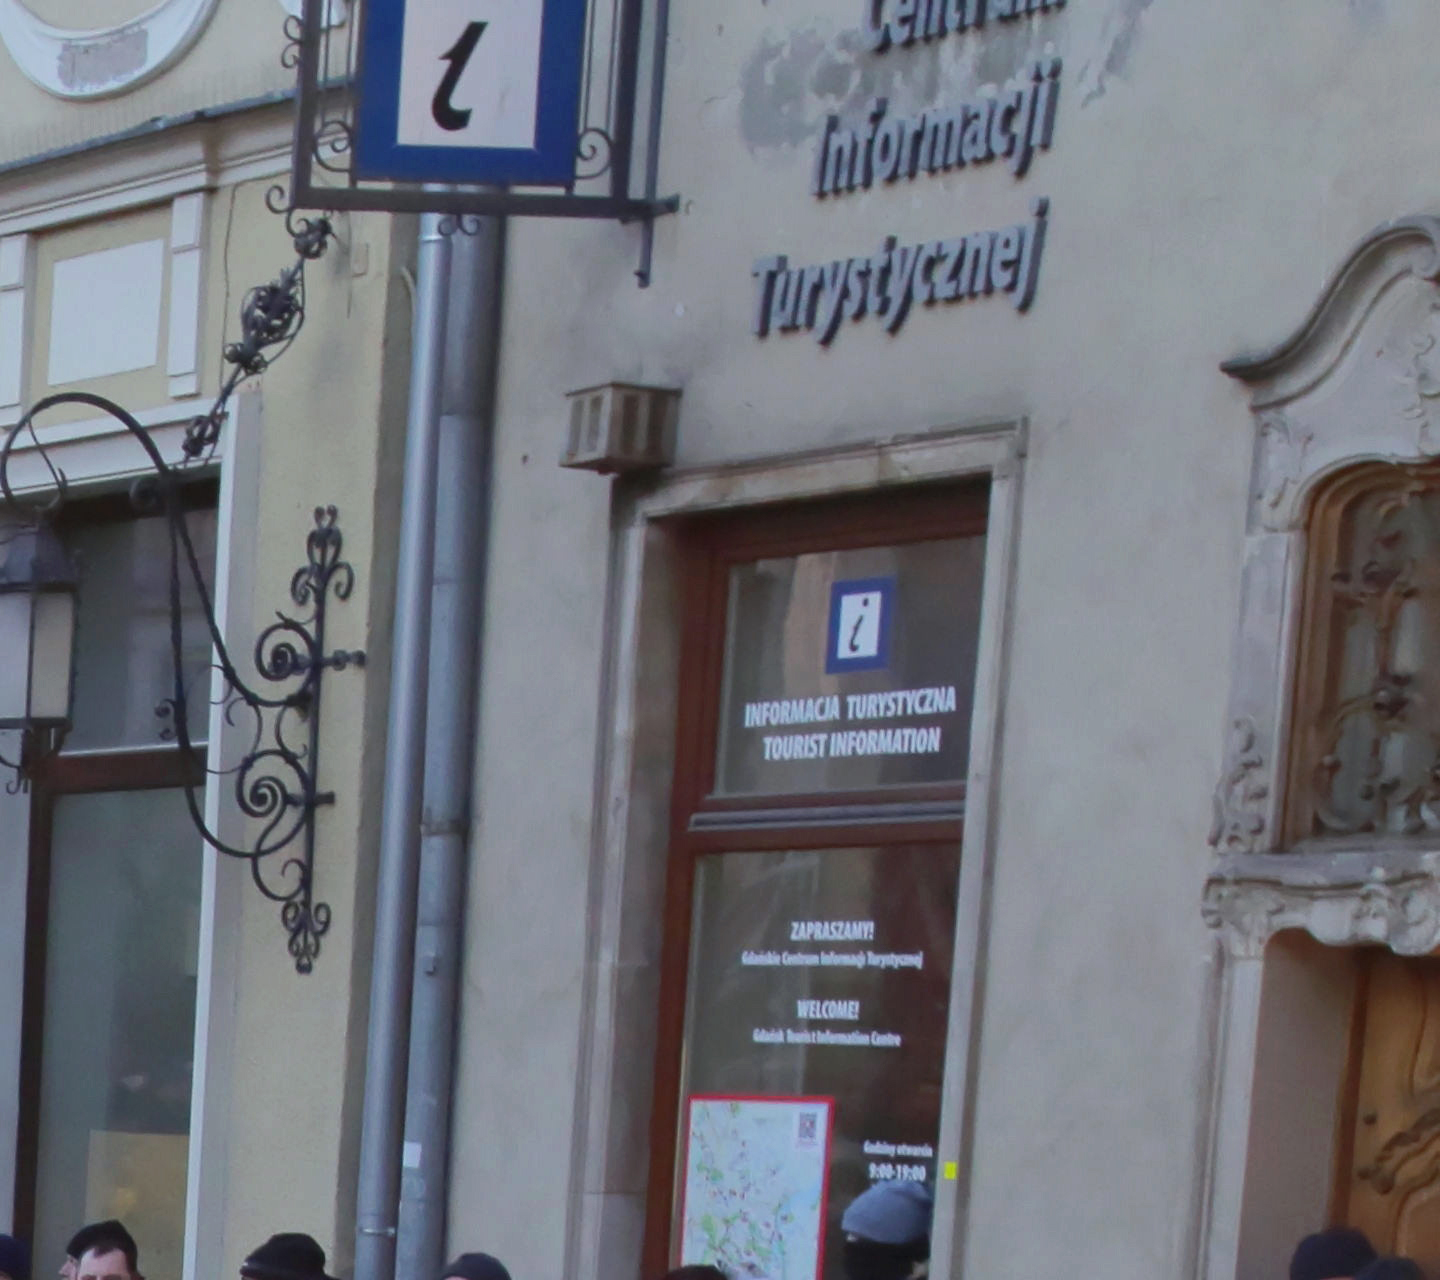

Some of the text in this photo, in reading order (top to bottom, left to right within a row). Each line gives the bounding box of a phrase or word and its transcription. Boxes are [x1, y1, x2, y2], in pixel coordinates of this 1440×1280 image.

[811, 56, 1063, 200] Informacji
[751, 196, 1050, 348] Turystycznej
[744, 685, 956, 728] INFORMACJA TURYSTYCZNA
[763, 727, 942, 760] TOURIST INFORMATION
[790, 920, 875, 941] ZAPRASZAMY!
[797, 1000, 860, 1020] WELCOME!
